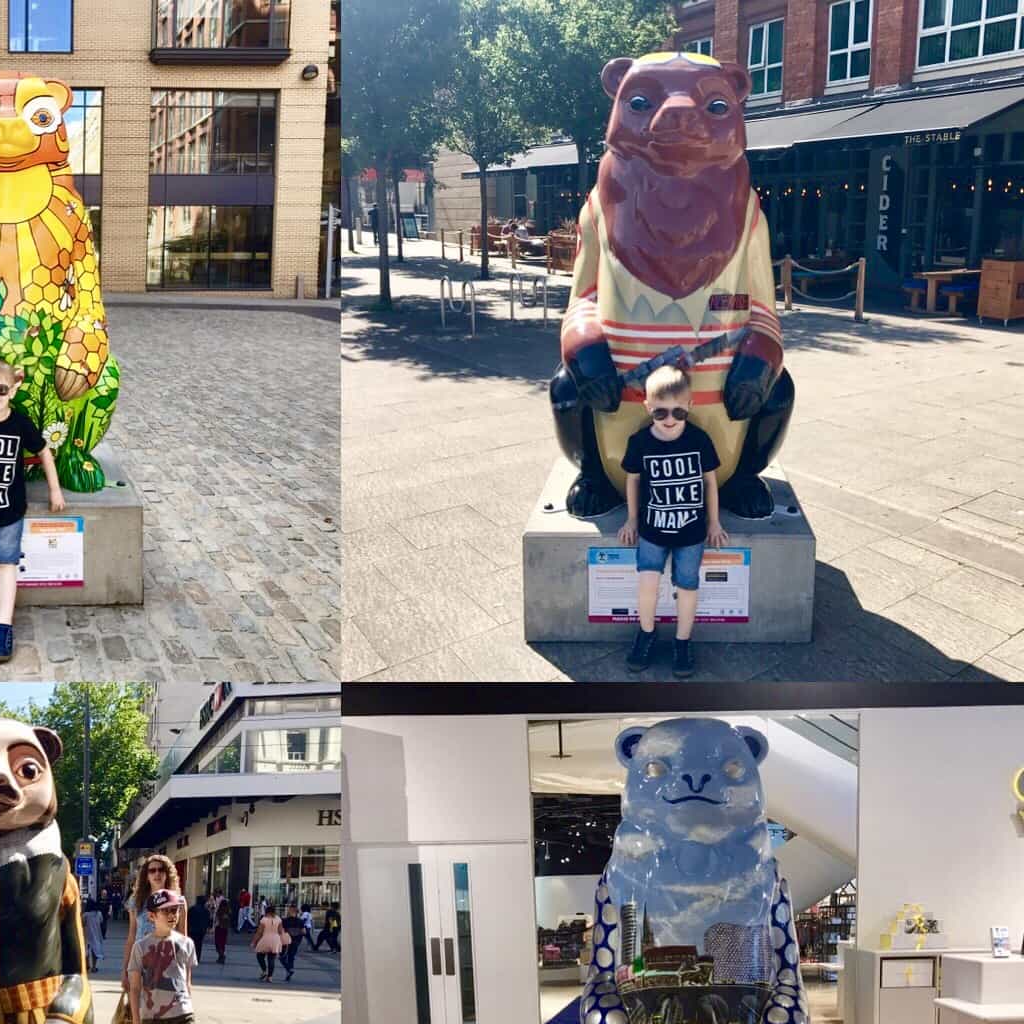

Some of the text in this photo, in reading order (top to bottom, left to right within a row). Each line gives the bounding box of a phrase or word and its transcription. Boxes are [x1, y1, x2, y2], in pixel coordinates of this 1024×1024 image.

[904, 131, 961, 144] THE STABLE
[877, 155, 892, 251] CIDER
[650, 456, 696, 478] COOL
[652, 484, 699, 505] LIKE
[654, 510, 696, 528] MAM
